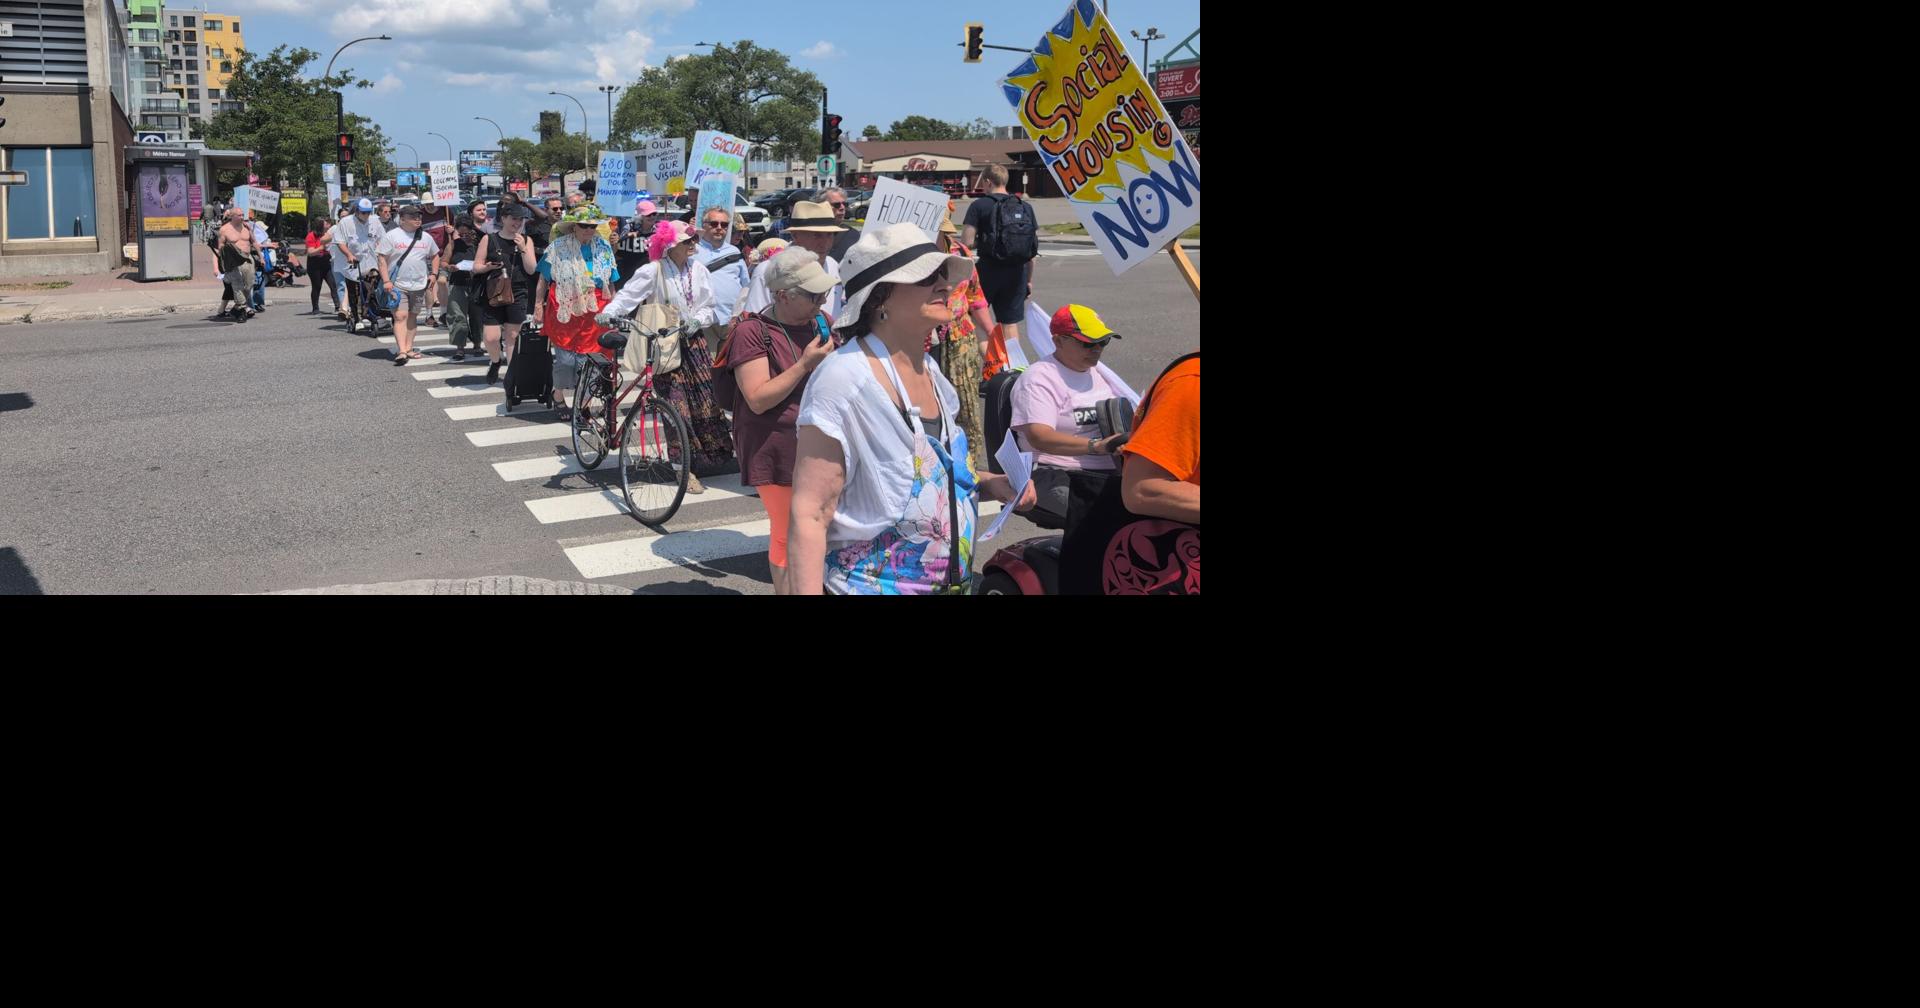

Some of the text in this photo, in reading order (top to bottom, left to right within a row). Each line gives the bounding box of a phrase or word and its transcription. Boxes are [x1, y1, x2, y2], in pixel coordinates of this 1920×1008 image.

[1159, 74, 1184, 83] OUVERT
[651, 140, 673, 149] OUR
[600, 158, 632, 170] 4800
[658, 160, 679, 171] OUR
[654, 168, 684, 181] VISION
[1092, 139, 1200, 260] NOW
